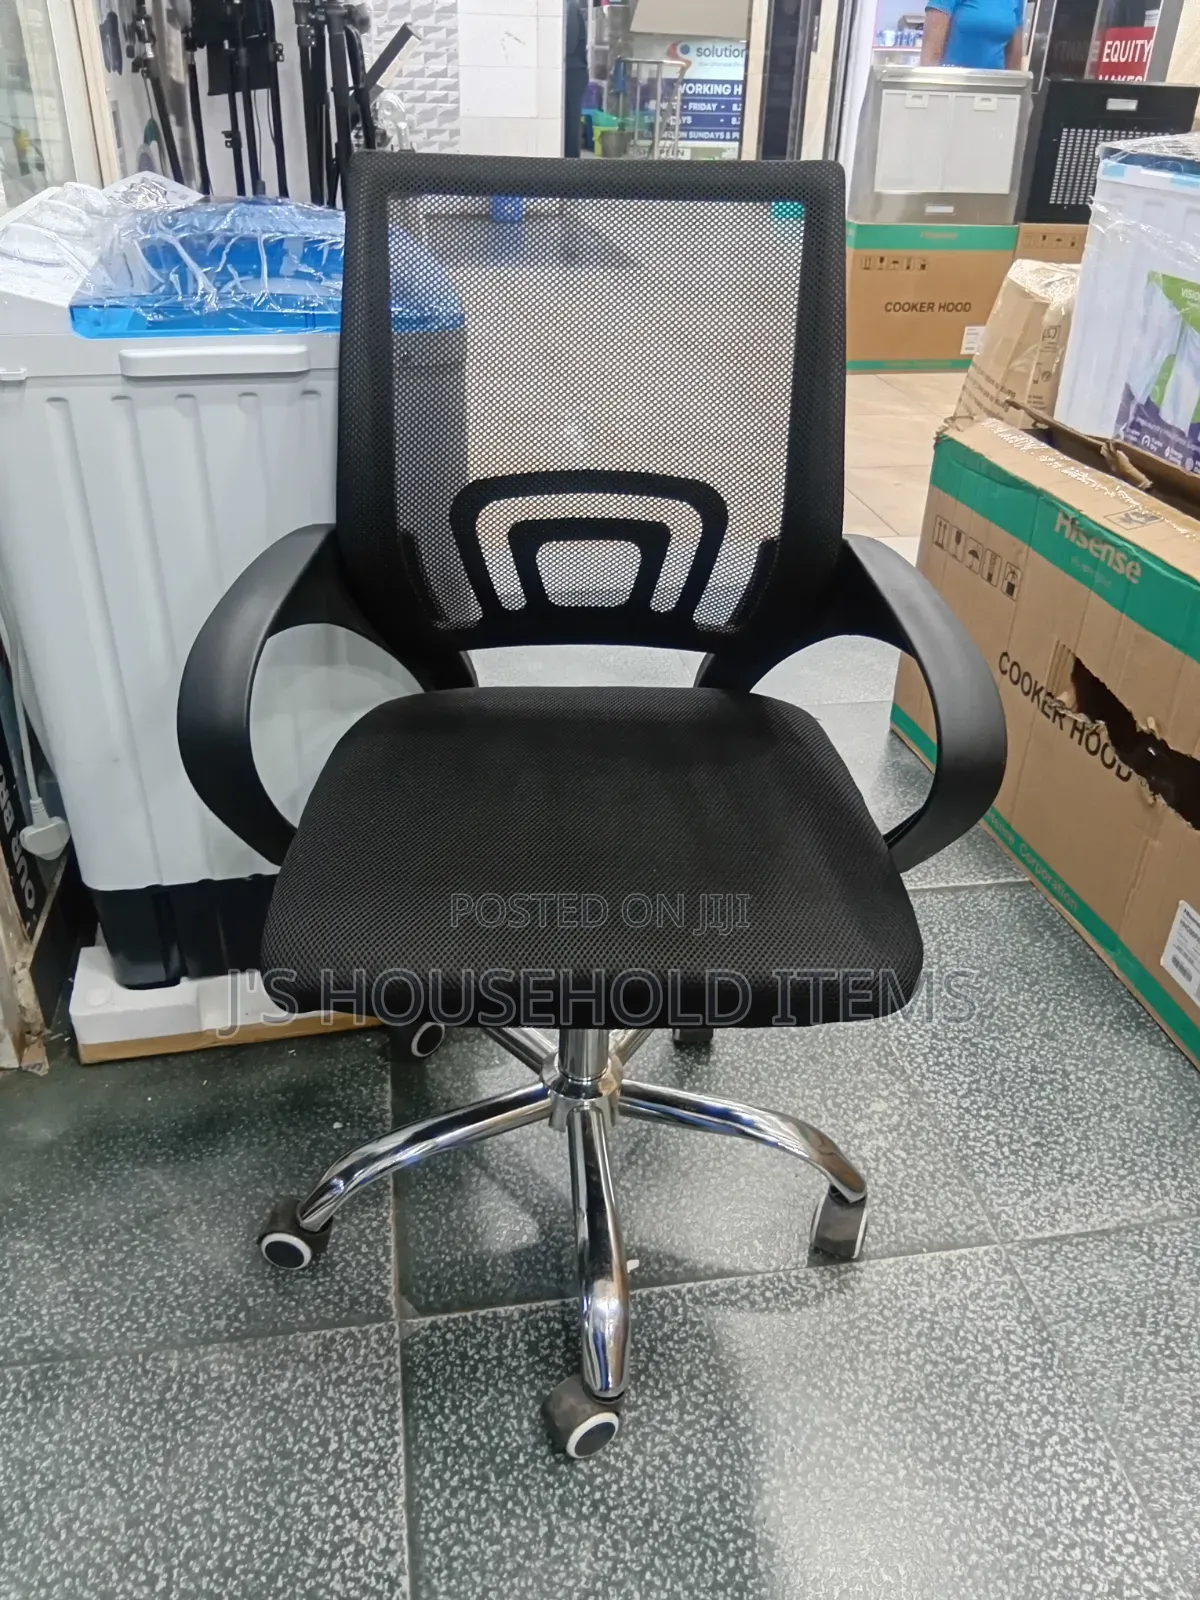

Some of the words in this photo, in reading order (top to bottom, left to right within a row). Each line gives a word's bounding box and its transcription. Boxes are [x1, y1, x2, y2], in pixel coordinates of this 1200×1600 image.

[1102, 39, 1154, 62] EQUITY
[688, 102, 718, 111] FRIDAY
[689, 131, 725, 139] SUNDAYS
[884, 301, 935, 313] COOKER
[937, 302, 972, 313] HOOD
[1054, 509, 1142, 584] Hisense
